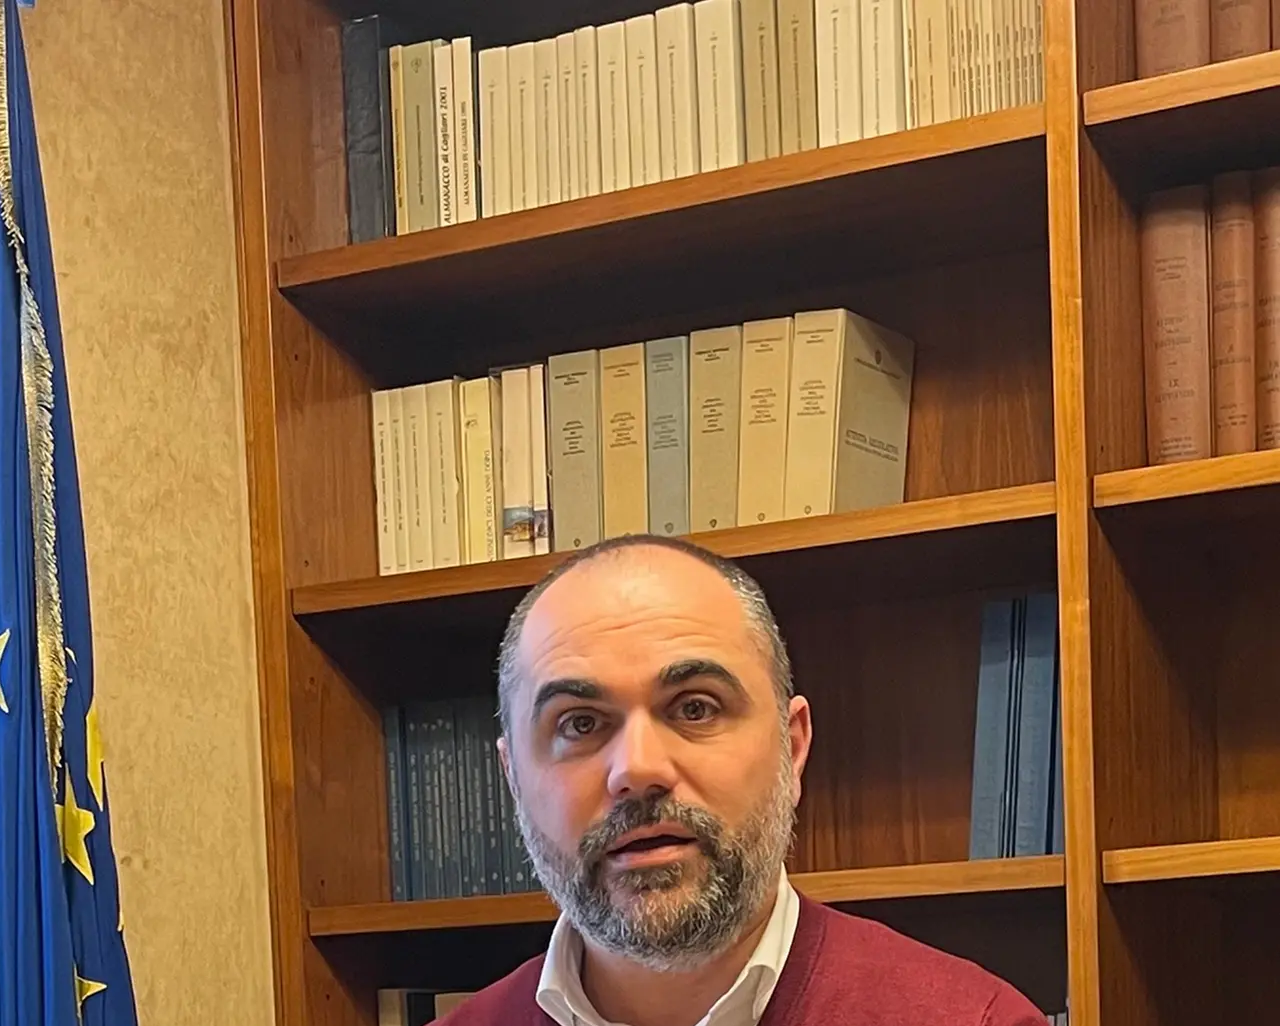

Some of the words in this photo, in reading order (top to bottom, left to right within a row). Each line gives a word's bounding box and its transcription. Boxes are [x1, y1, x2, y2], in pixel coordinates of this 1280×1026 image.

[439, 86, 448, 110] 2001
[440, 113, 451, 150] Cagliari
[440, 166, 452, 224] ALMANACCO
